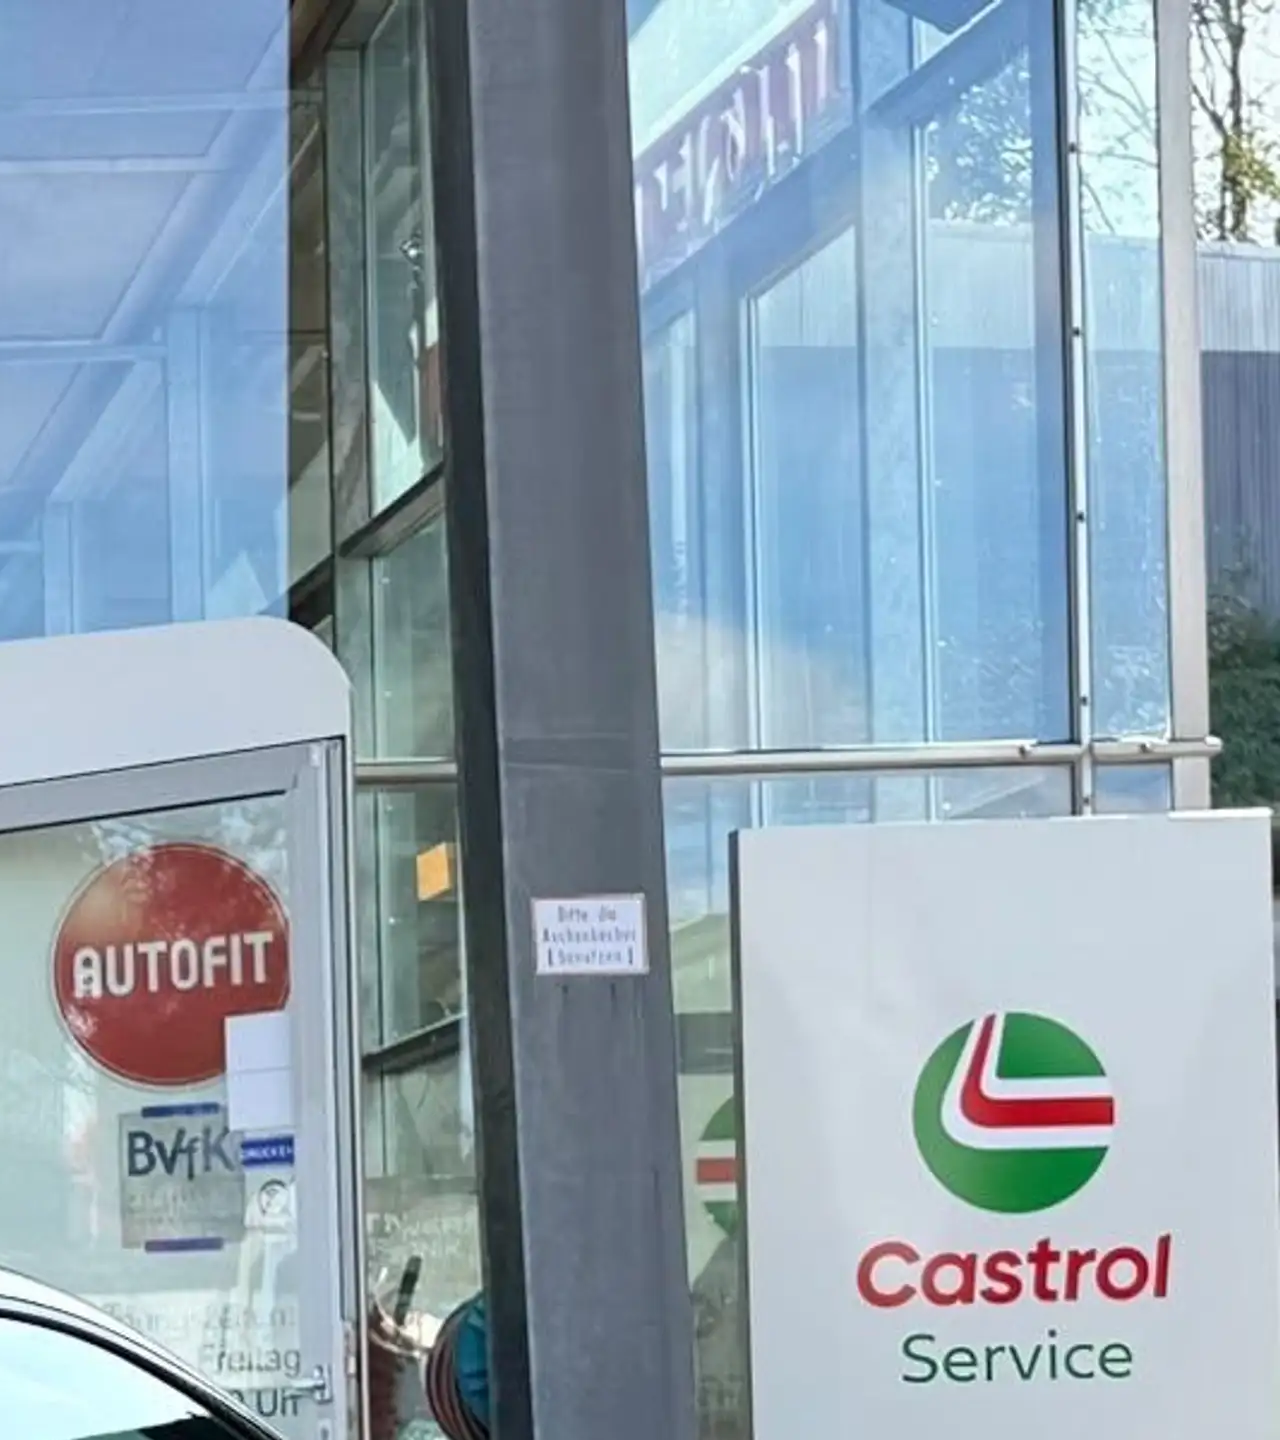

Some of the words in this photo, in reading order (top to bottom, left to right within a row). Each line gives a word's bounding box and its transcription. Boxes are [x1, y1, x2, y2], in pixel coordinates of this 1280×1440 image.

[73, 931, 273, 1000] AUTOFIT
[857, 1232, 1172, 1308] Castrol
[901, 1329, 1133, 1384] Service
